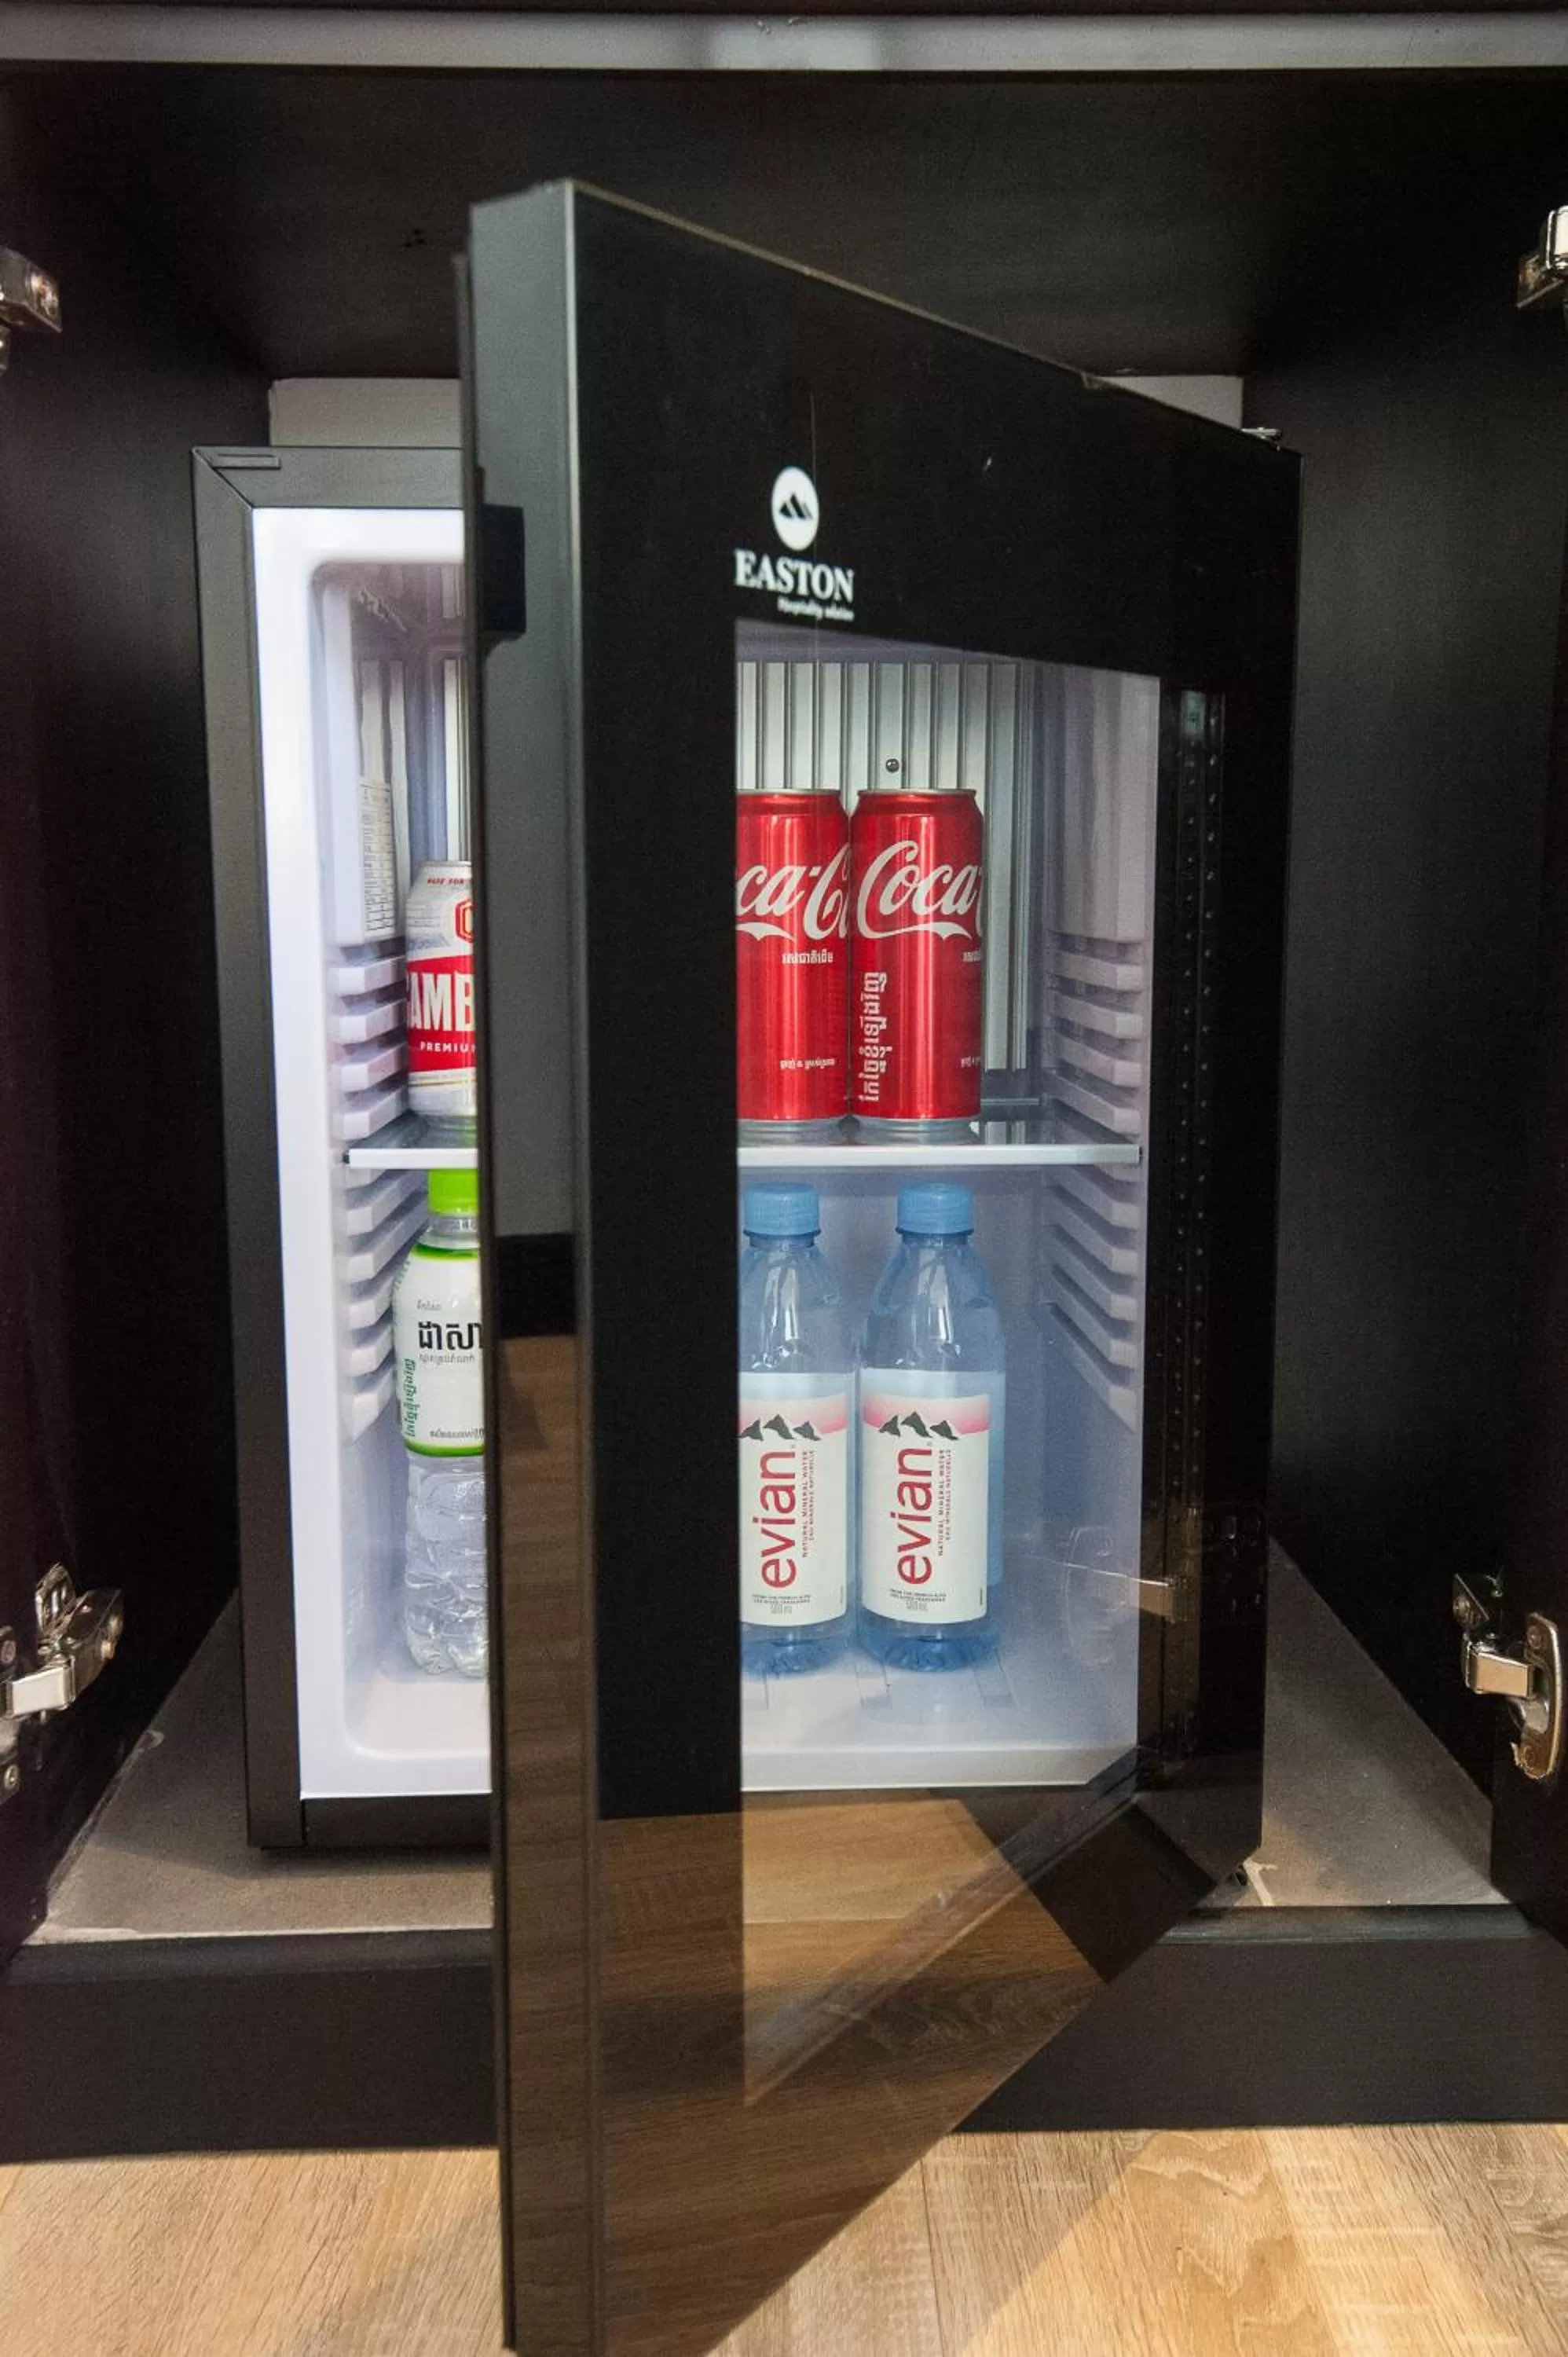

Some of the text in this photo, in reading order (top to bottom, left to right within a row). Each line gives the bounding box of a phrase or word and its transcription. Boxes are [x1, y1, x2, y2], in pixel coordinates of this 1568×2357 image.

[735, 548, 854, 603] EASTON
[407, 972, 475, 1032] AMB
[752, 1451, 797, 1588] evian
[890, 1448, 932, 1585] evian
